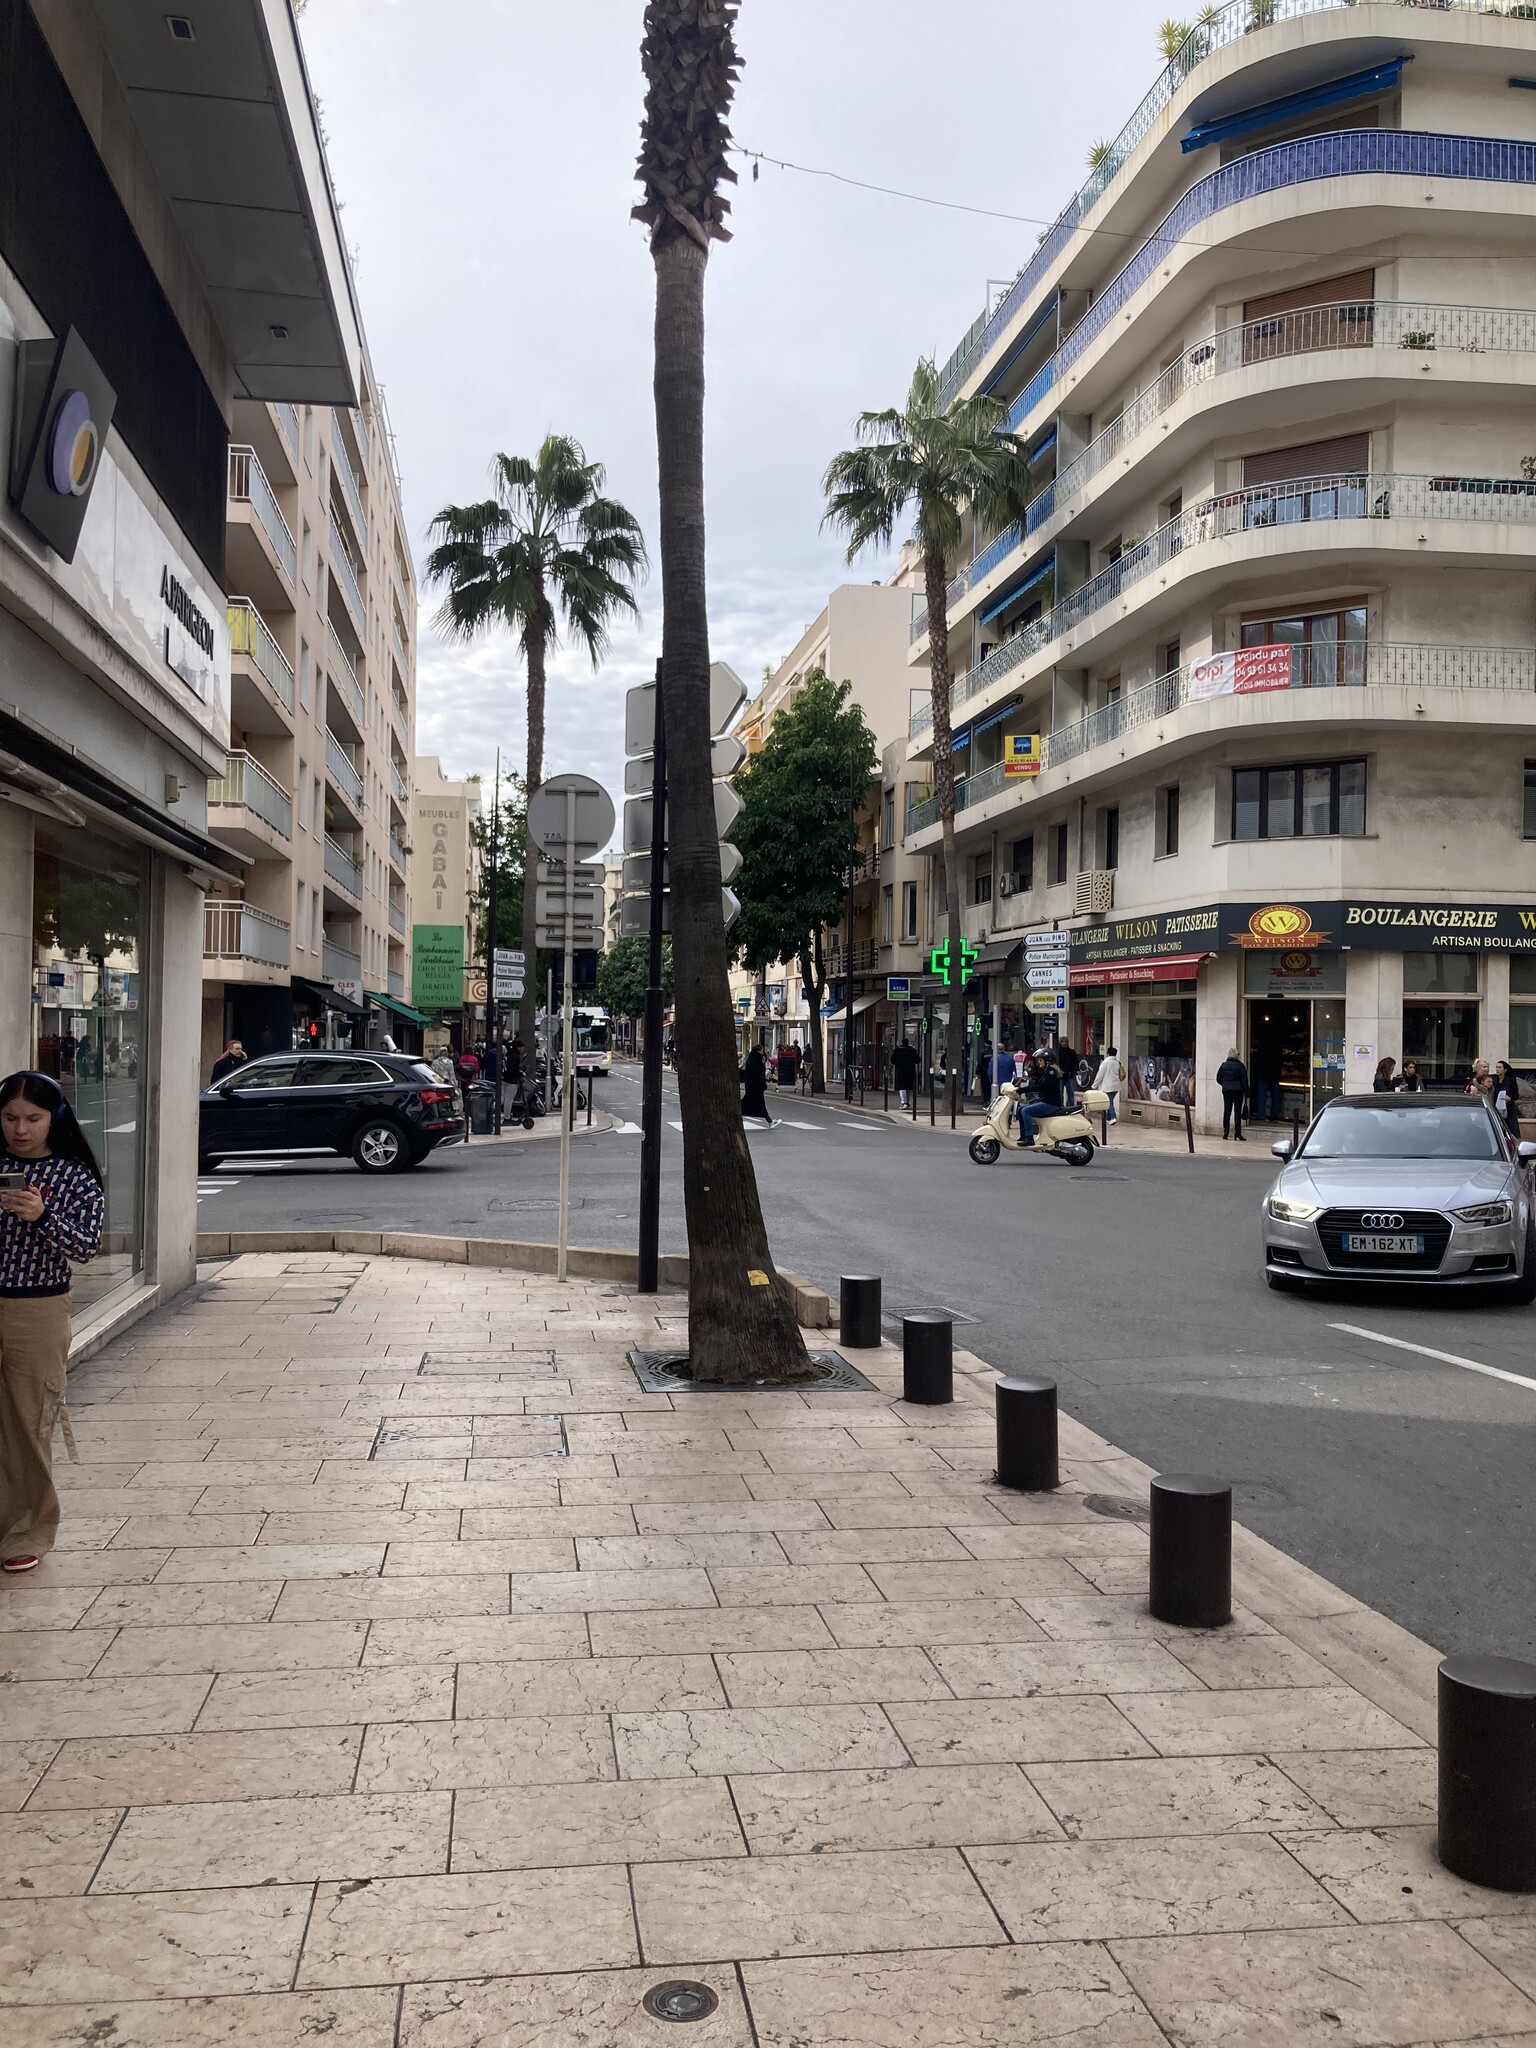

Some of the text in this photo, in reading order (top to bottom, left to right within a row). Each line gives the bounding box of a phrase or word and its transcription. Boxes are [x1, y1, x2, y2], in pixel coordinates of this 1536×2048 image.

[1237, 648, 1290, 662] Vendu par
[1236, 662, 1290, 676] 04 93 61 34 34
[1254, 678, 1289, 688] IMMOBILIER
[419, 810, 460, 818] MEUBLES
[432, 822, 448, 910] GABAÏ
[1266, 916, 1294, 928] W
[1346, 907, 1498, 928] BOULANGERIE
[1116, 920, 1158, 940] WILSON
[1165, 912, 1219, 934] PATISSERIE
[1432, 936, 1480, 947] ARTISAN
[1086, 951, 1102, 960] ARTISAN
[1103, 948, 1127, 958] BOULANGER
[1130, 944, 1152, 955] PATISSIER
[1157, 941, 1182, 952] SNACKING
[1071, 975, 1084, 983] Artisan
[1085, 973, 1104, 983] Boulanger
[1133, 969, 1154, 979] Snacking
[1352, 1237, 1414, 1251] EM-162-XT
